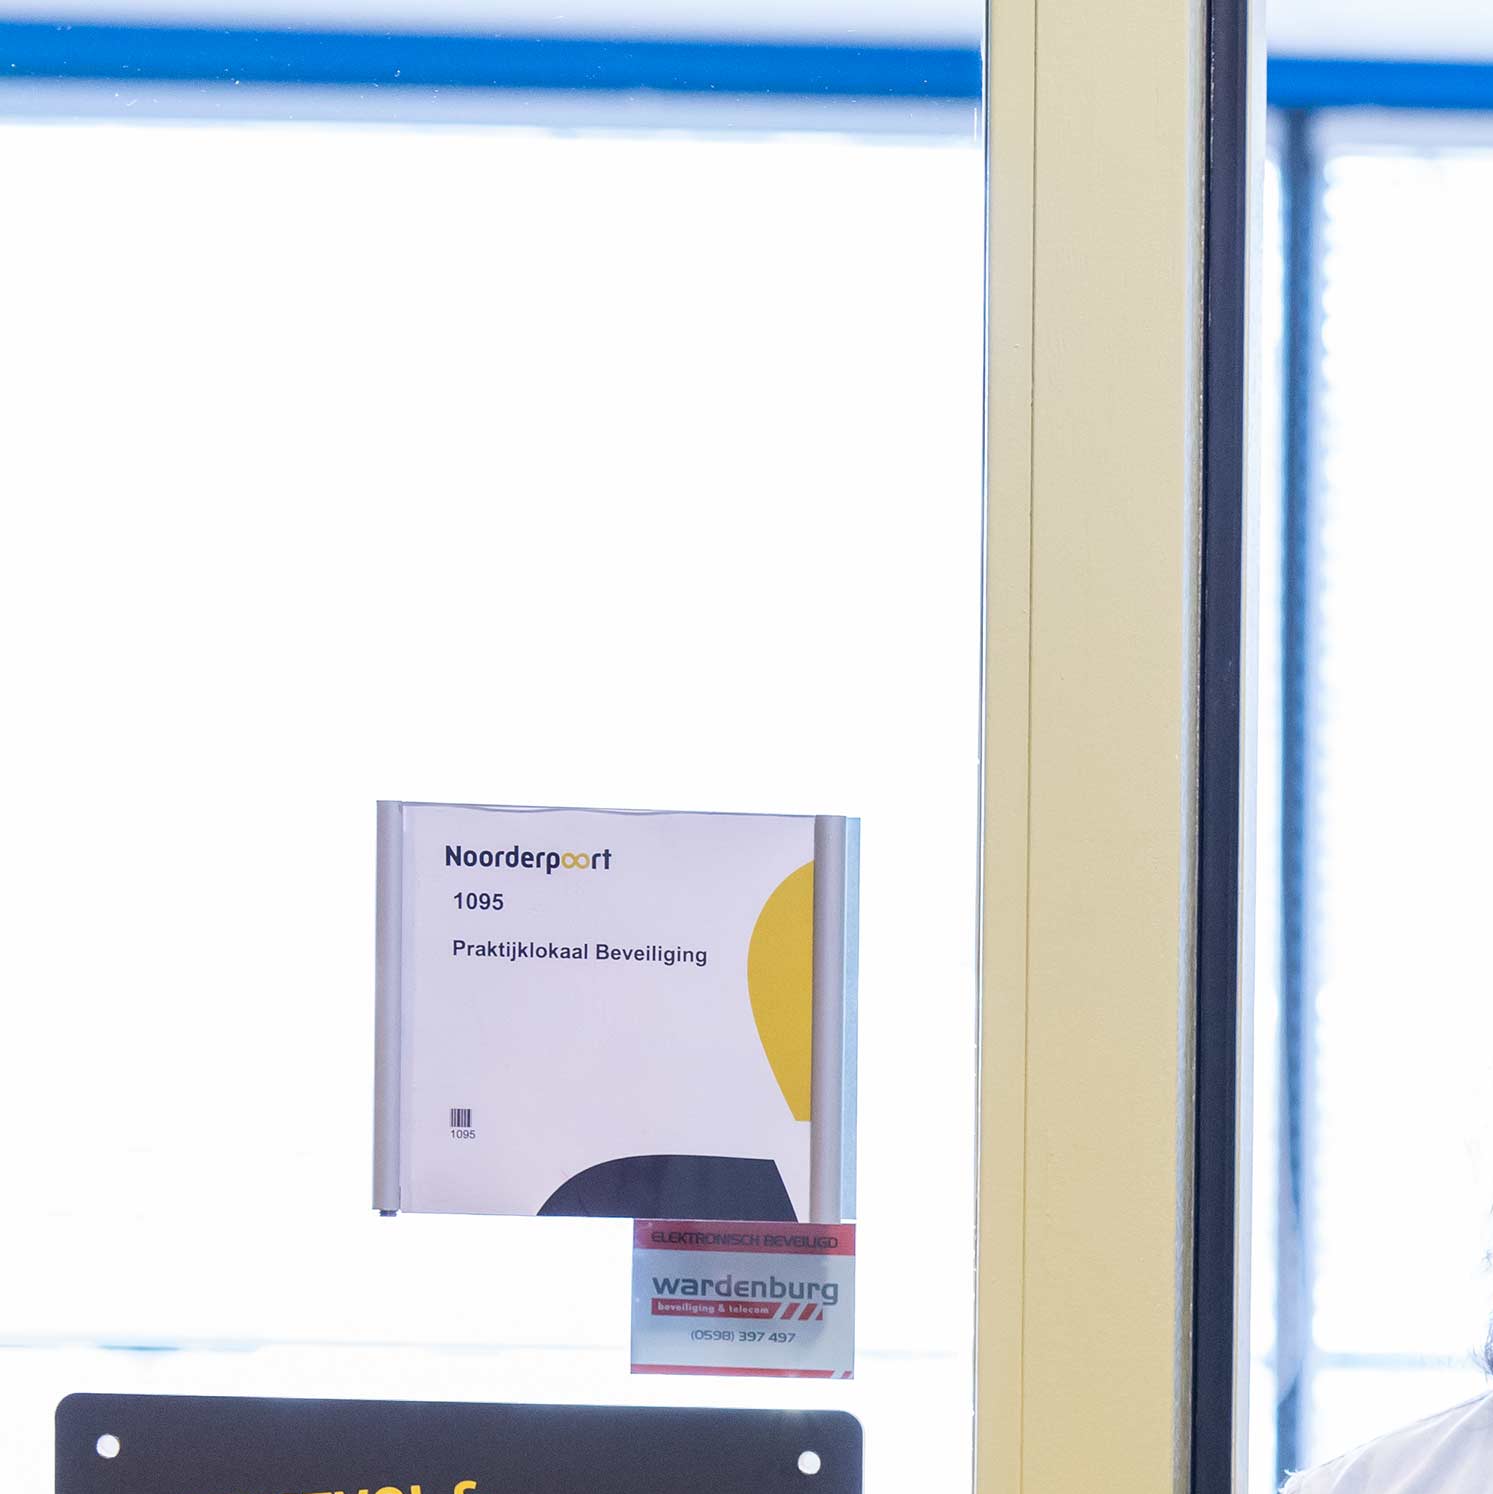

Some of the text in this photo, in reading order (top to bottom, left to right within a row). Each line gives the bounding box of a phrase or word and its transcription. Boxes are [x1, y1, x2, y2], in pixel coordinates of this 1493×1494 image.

[445, 845, 612, 874] Noorderpoort
[453, 892, 504, 911] 1095
[452, 939, 707, 967] Praktijklokaal Beveiliging
[450, 1129, 476, 1140] 1095
[651, 1230, 839, 1249] ELEKTRONISCH BEVEILIGD
[651, 1274, 839, 1306] wardenburg
[657, 1301, 769, 1315] beveiliging & telecom
[690, 1329, 797, 1344] (0598) 397 497
